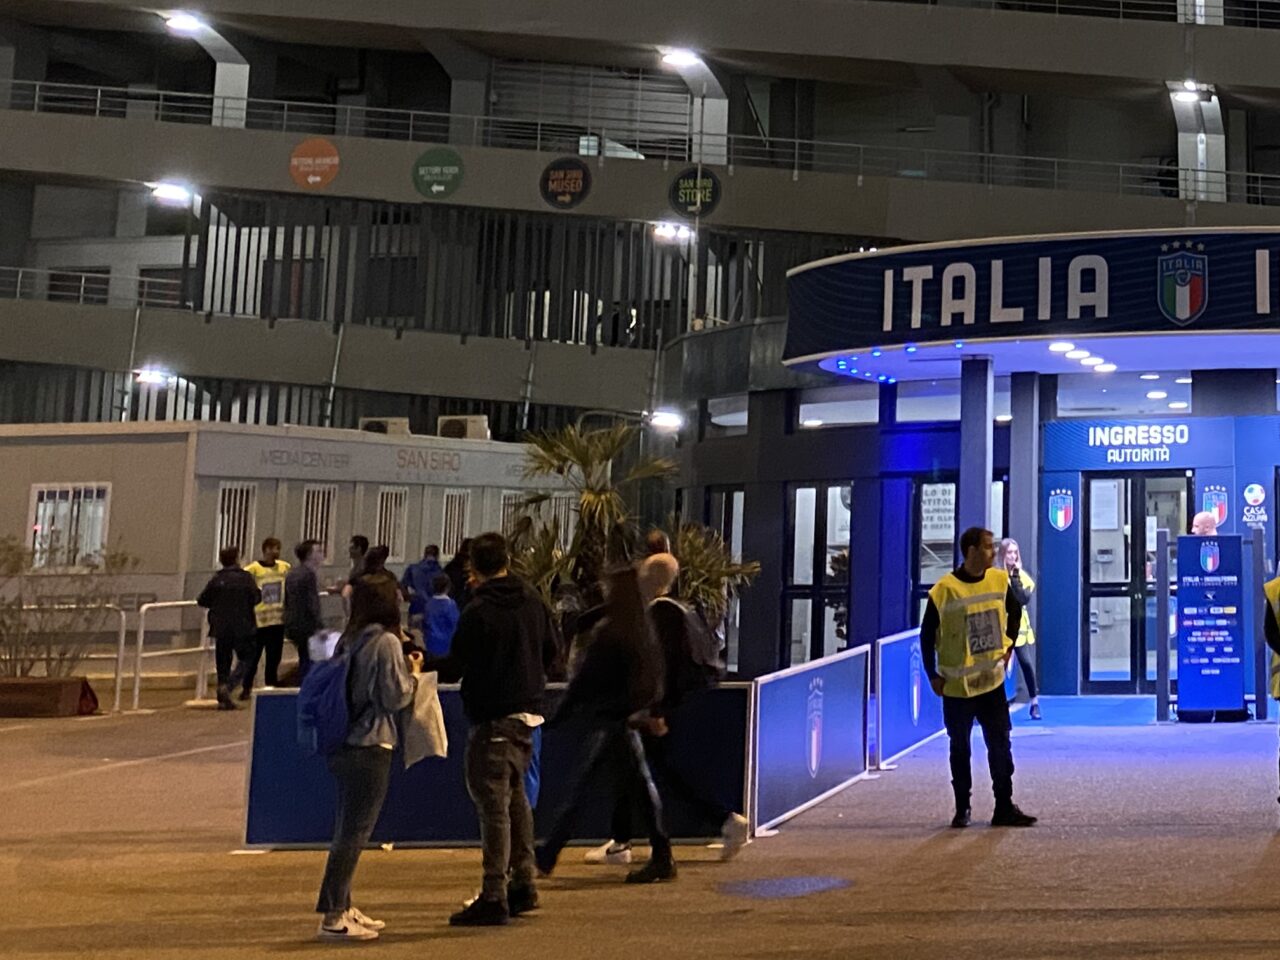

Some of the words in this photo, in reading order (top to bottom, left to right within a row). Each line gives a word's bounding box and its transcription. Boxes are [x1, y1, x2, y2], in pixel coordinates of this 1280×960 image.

[548, 179, 583, 192] MUSEO
[679, 178, 694, 189] SAN
[678, 189, 712, 203] STORE
[1162, 258, 1203, 271] ITALIA
[882, 254, 1109, 331] ITALIA
[1088, 424, 1188, 446] INGRESSO
[1107, 445, 1170, 463] AUTORITÀ
[1244, 506, 1265, 515] CASA
